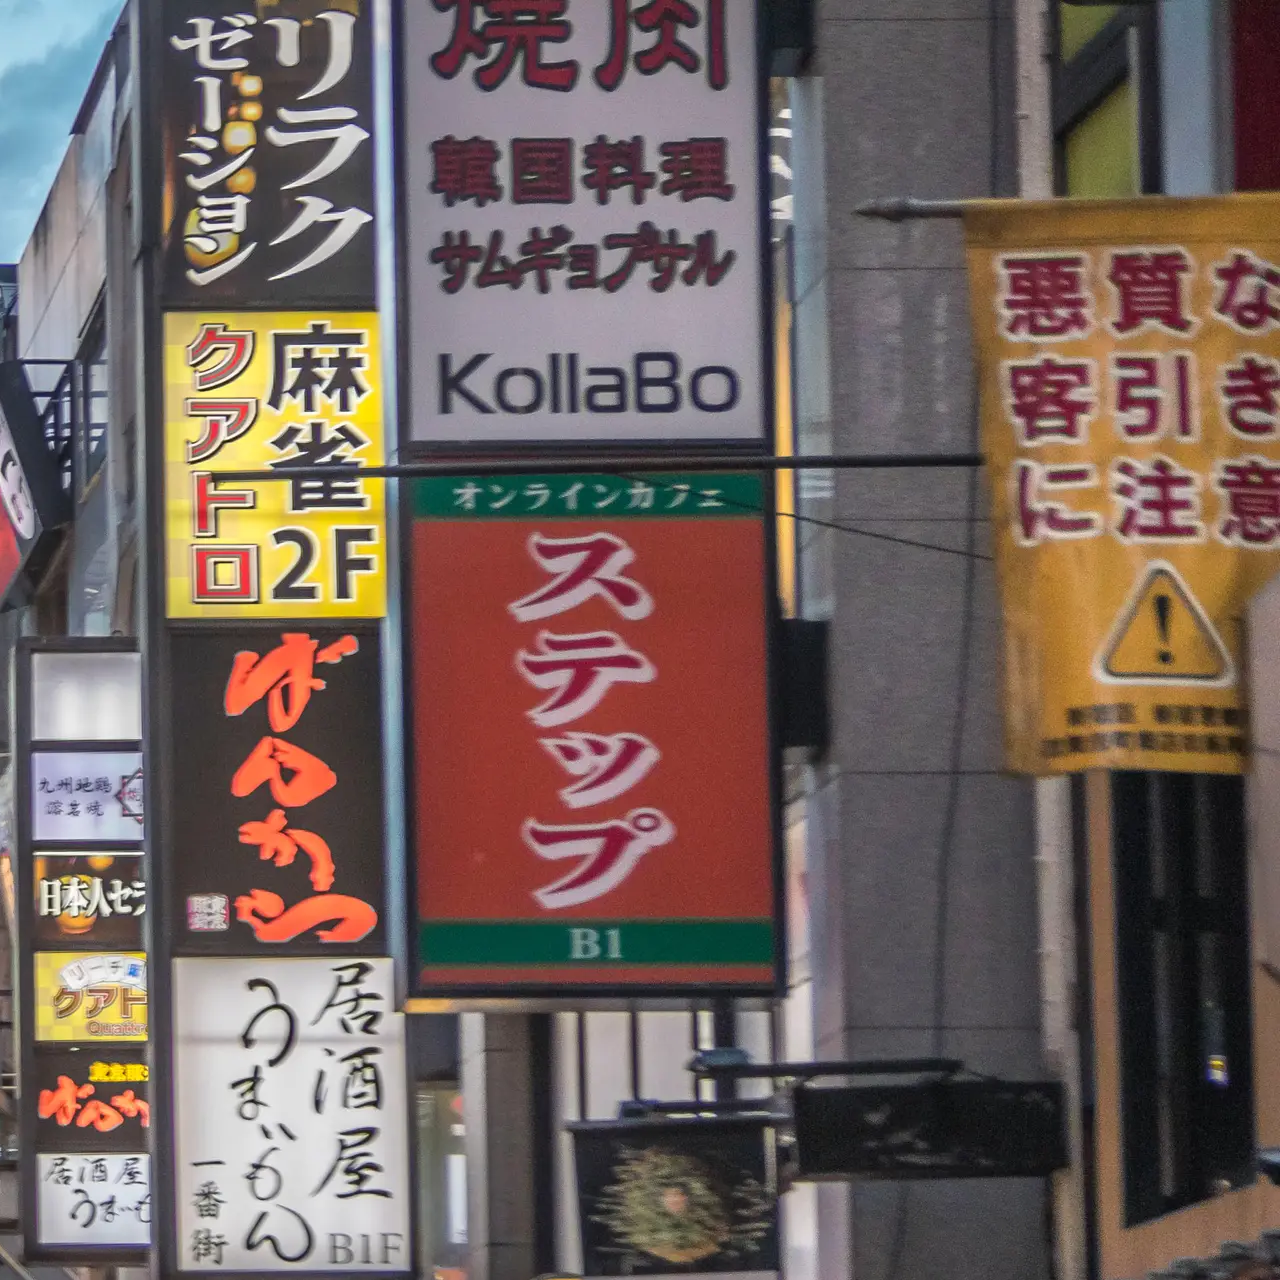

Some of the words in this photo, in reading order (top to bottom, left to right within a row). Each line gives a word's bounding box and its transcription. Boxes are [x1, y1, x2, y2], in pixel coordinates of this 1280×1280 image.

[169, 14, 258, 287] ゼーション
[262, 10, 375, 283] リラク
[429, 133, 737, 208] 韓国料理
[429, 222, 737, 294] サムギョプサル
[998, 248, 1280, 339] 悪質な
[262, 320, 374, 514] 麻雀
[439, 352, 740, 415] KollaBo
[1008, 351, 1280, 445] 客引き
[183, 322, 262, 604] クアトロ
[451, 481, 726, 512] オンラインカフェ
[1016, 454, 1280, 550] に注意
[269, 525, 378, 603] 2F
[506, 530, 678, 911] ステップ
[223, 632, 378, 944] ばんから
[569, 929, 625, 960] B1
[229, 978, 315, 1263] うまいもん
[310, 962, 393, 1201] 居酒屋
[44, 1157, 148, 1185] 居酒屋
[189, 1157, 231, 1267] 一番街
[326, 1233, 405, 1266] B1F
